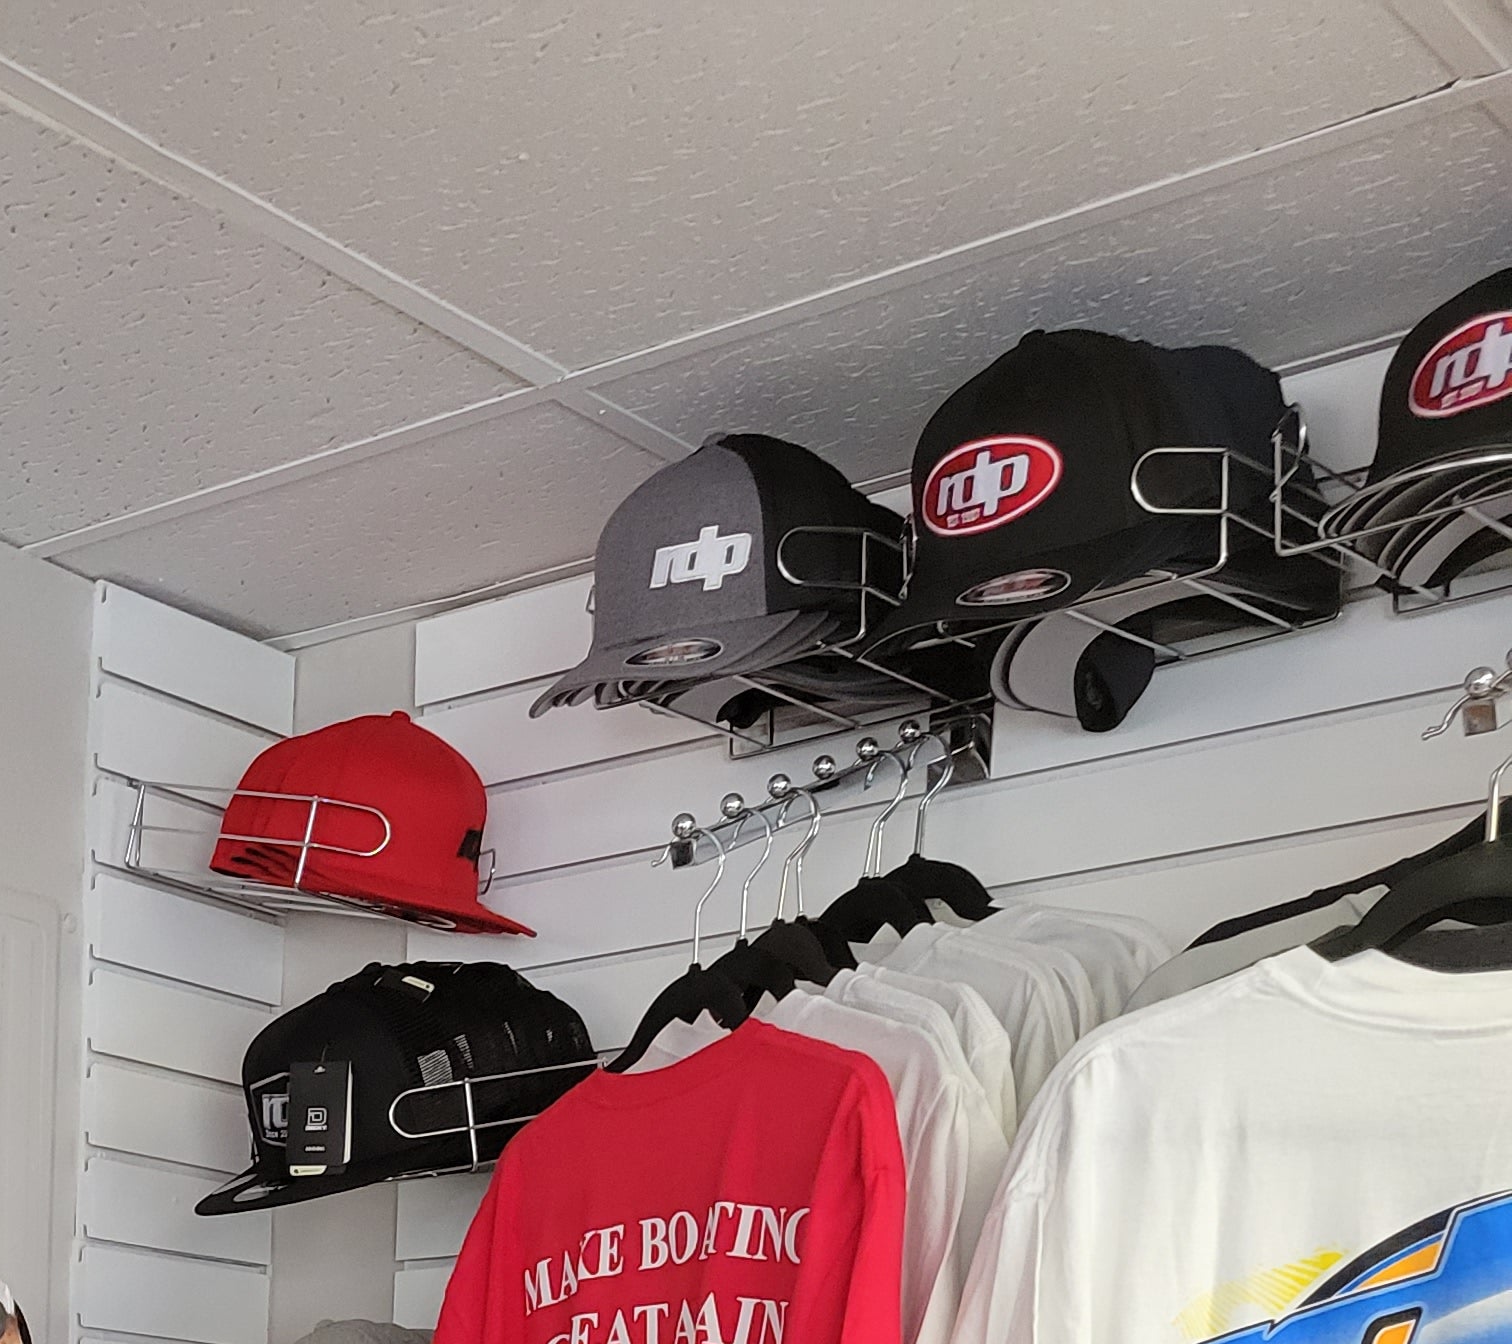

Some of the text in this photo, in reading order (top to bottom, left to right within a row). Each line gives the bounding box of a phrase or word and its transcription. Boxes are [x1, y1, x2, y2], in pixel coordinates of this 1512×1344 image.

[936, 450, 1030, 517] rdp
[649, 525, 752, 591] rdp
[262, 1093, 289, 1129] rd
